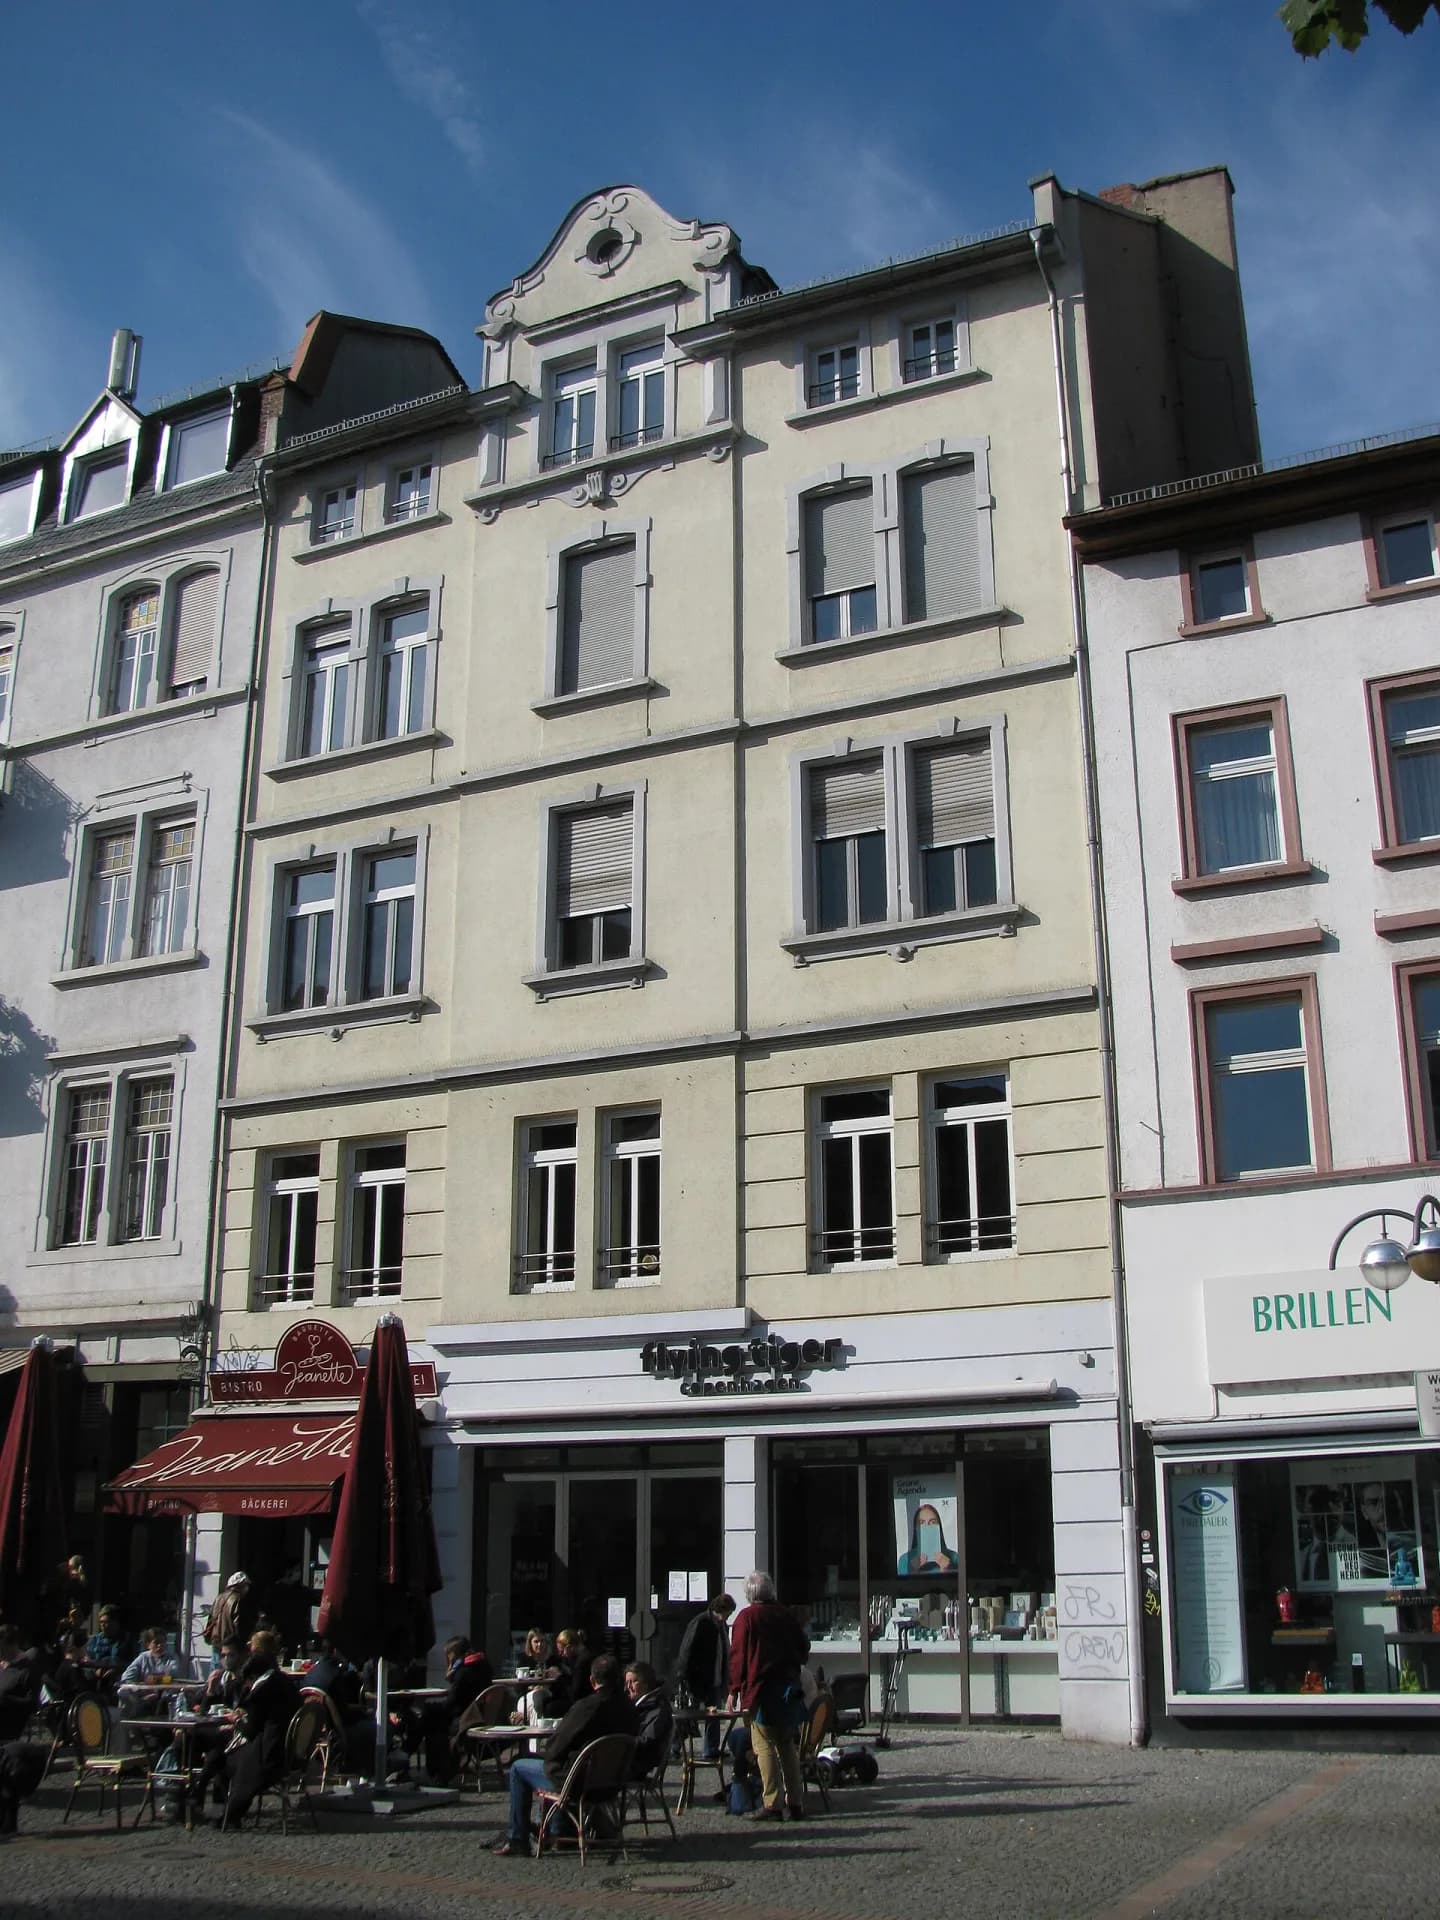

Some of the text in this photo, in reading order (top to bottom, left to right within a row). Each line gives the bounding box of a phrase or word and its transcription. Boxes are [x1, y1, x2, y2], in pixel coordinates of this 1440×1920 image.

[1253, 1287, 1392, 1332] BRILLEN
[640, 1333, 843, 1379] flying tiger
[280, 1361, 354, 1395] Jeanette
[220, 1380, 263, 1393] BISTRO
[680, 1376, 800, 1395] copenhagen
[897, 1486, 927, 1495] Agenda
[241, 1497, 289, 1509] BÄCKEREI
[1340, 1551, 1358, 1561] YOUR
[1340, 1570, 1360, 1580] HERO
